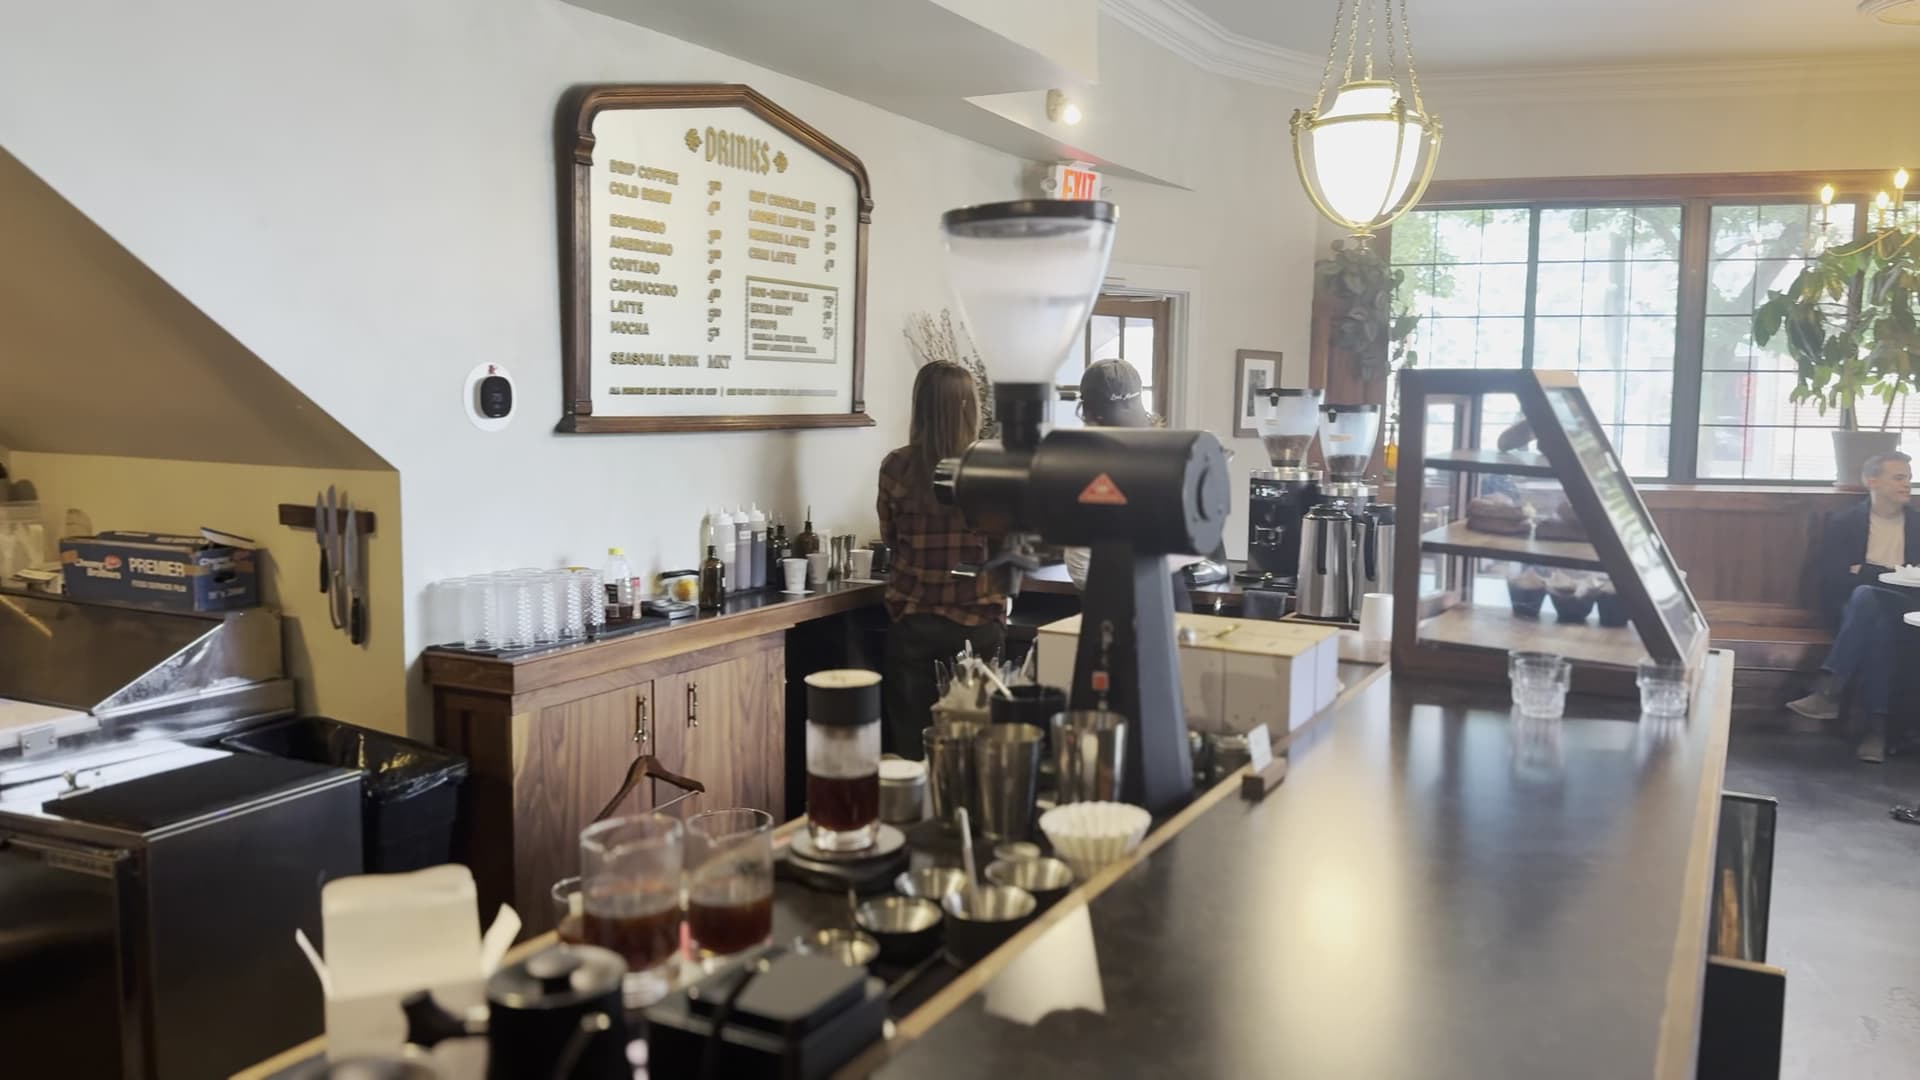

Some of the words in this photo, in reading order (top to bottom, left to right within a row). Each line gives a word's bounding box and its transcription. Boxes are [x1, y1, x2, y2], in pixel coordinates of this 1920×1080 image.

[705, 126, 770, 176] DRINKS
[638, 165, 679, 186] COFFEE
[1063, 169, 1096, 201] EXIT
[609, 181, 639, 199] COLD
[609, 213, 666, 235] ESPRESSO
[609, 235, 673, 256] AMERICANO
[609, 256, 660, 275] CORTADO
[770, 249, 797, 265] LATTE
[609, 278, 678, 298] CAPPUCCINO
[610, 299, 643, 315] LATTE
[610, 320, 649, 335] MOCHA
[609, 351, 666, 366] SEASONAL
[668, 353, 699, 367] DRINK
[128, 557, 185, 578] PREMIER
